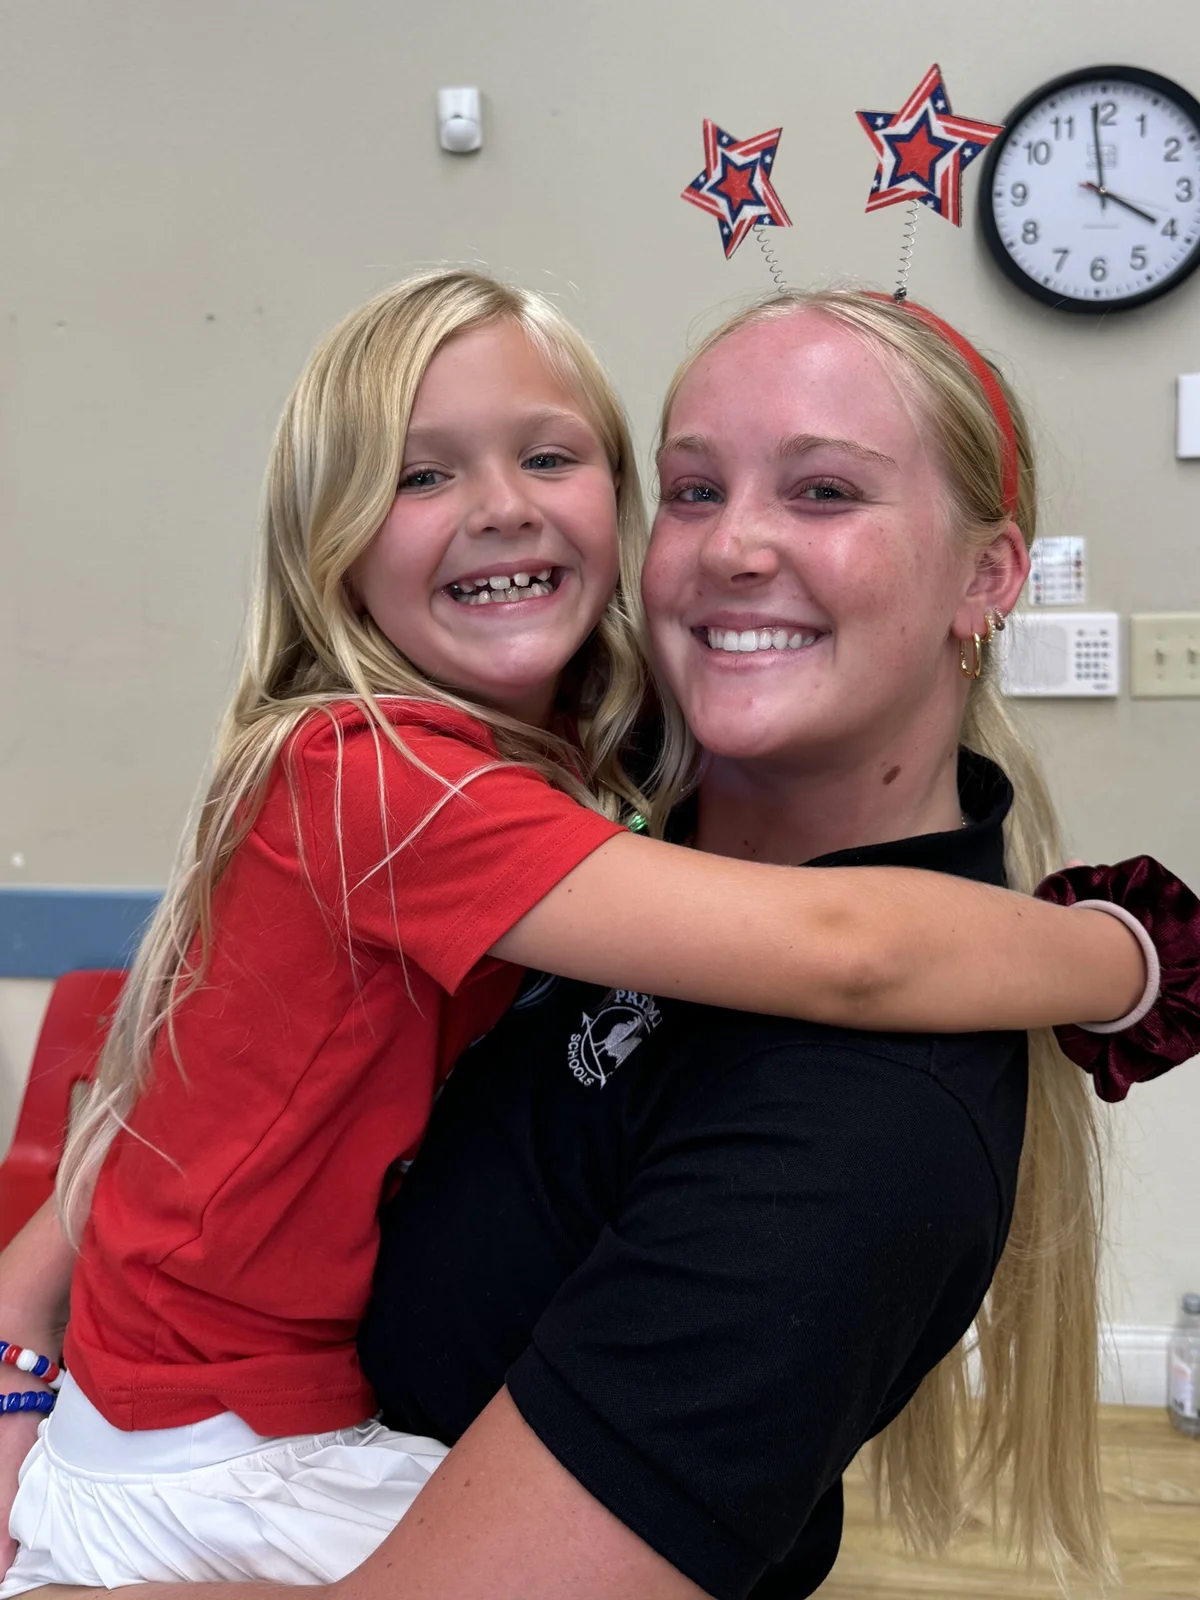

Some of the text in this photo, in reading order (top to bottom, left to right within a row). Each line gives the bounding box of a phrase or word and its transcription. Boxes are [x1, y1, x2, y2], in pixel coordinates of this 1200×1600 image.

[1051, 115, 1074, 141] 11
[1136, 113, 1147, 138] 1
[1024, 141, 1051, 166] 10
[1163, 137, 1181, 162] 2
[1010, 182, 1028, 207] 9
[1175, 178, 1194, 202] 3
[1021, 220, 1038, 245] 8
[1160, 218, 1179, 240] 4
[1052, 249, 1070, 273] 7
[1089, 257, 1107, 282] 6
[1129, 245, 1147, 271] 5
[567, 1033, 595, 1086] SCHOOLS
